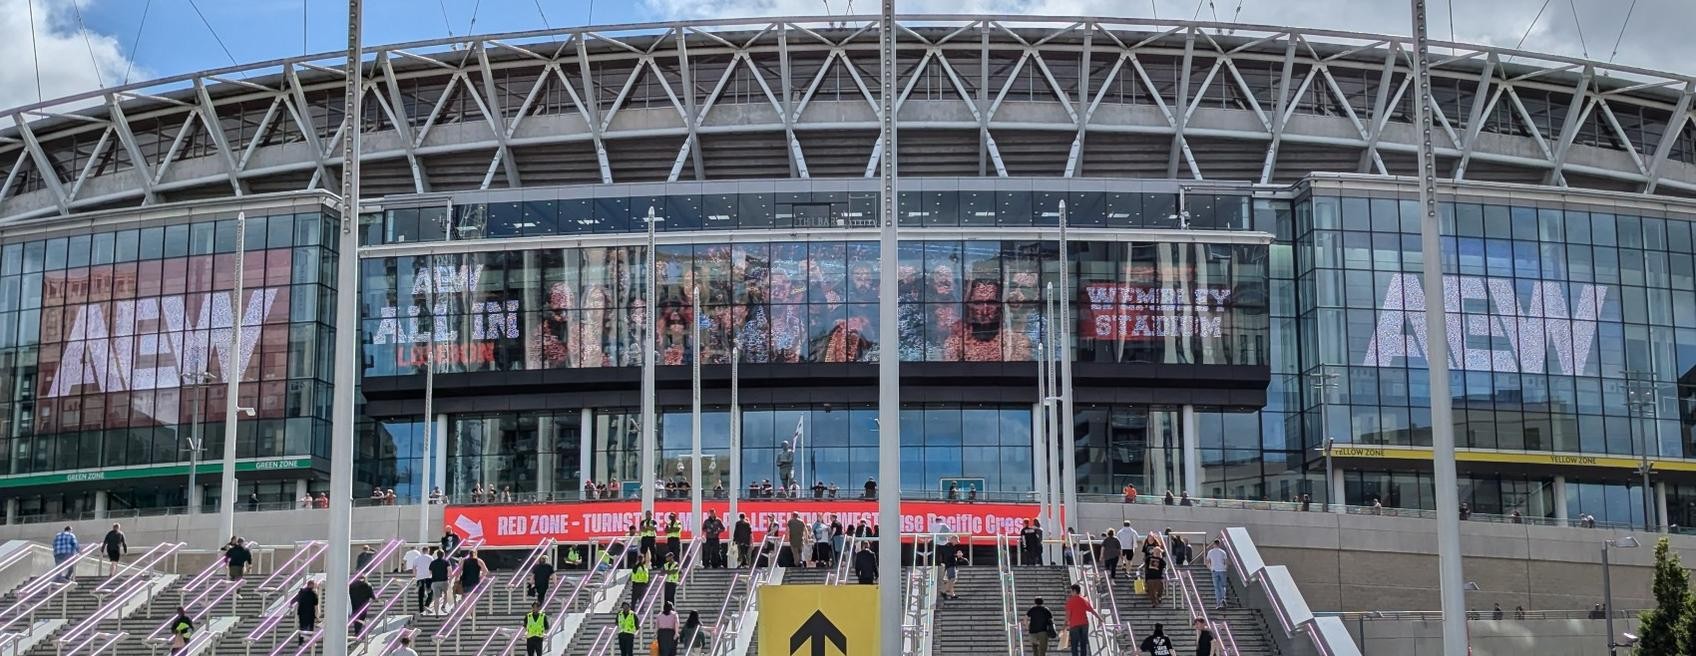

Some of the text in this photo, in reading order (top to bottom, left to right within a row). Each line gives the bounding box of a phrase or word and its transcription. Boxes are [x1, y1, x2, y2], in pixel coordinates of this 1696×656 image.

[411, 264, 484, 295] AEW
[1086, 286, 1231, 312] WEMBLEY
[373, 299, 520, 344] ALL IN
[1095, 315, 1222, 337] STADIUM
[1363, 272, 1608, 376] AEW
[48, 288, 278, 397] AEW
[1335, 447, 1384, 456] YELLOW ZONE
[1550, 455, 1596, 465] YELLOW ZONE
[67, 471, 104, 481] GREEN ZONE
[256, 460, 297, 470] GREEN ZONE
[498, 515, 527, 535] RED
[530, 514, 569, 535] ZONE
[583, 511, 672, 532] TURNSTES
[986, 515, 1024, 535] Cres
